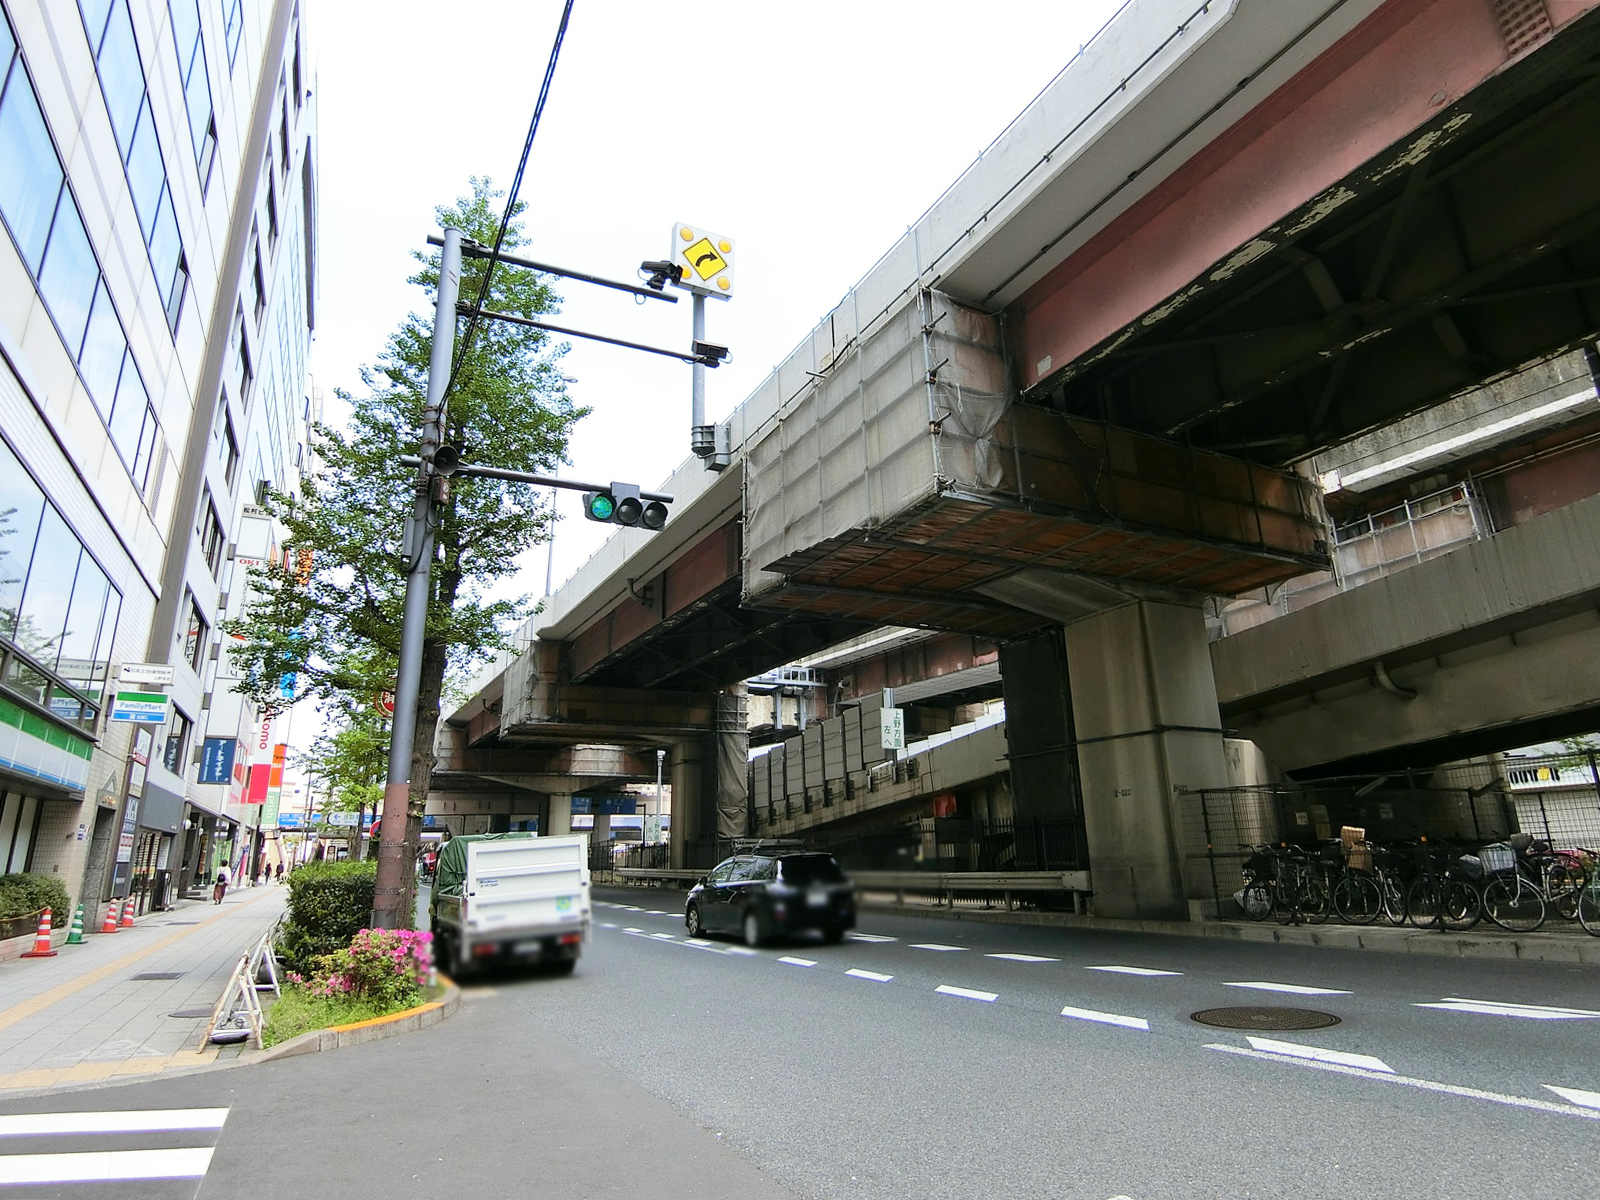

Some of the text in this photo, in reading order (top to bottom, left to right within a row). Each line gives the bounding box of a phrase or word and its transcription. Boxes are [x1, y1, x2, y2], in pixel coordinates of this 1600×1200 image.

[239, 559, 260, 567] OKI
[119, 702, 162, 710] FamilyMart
[883, 725, 892, 746] 左へ
[894, 710, 902, 747] 上野方面
